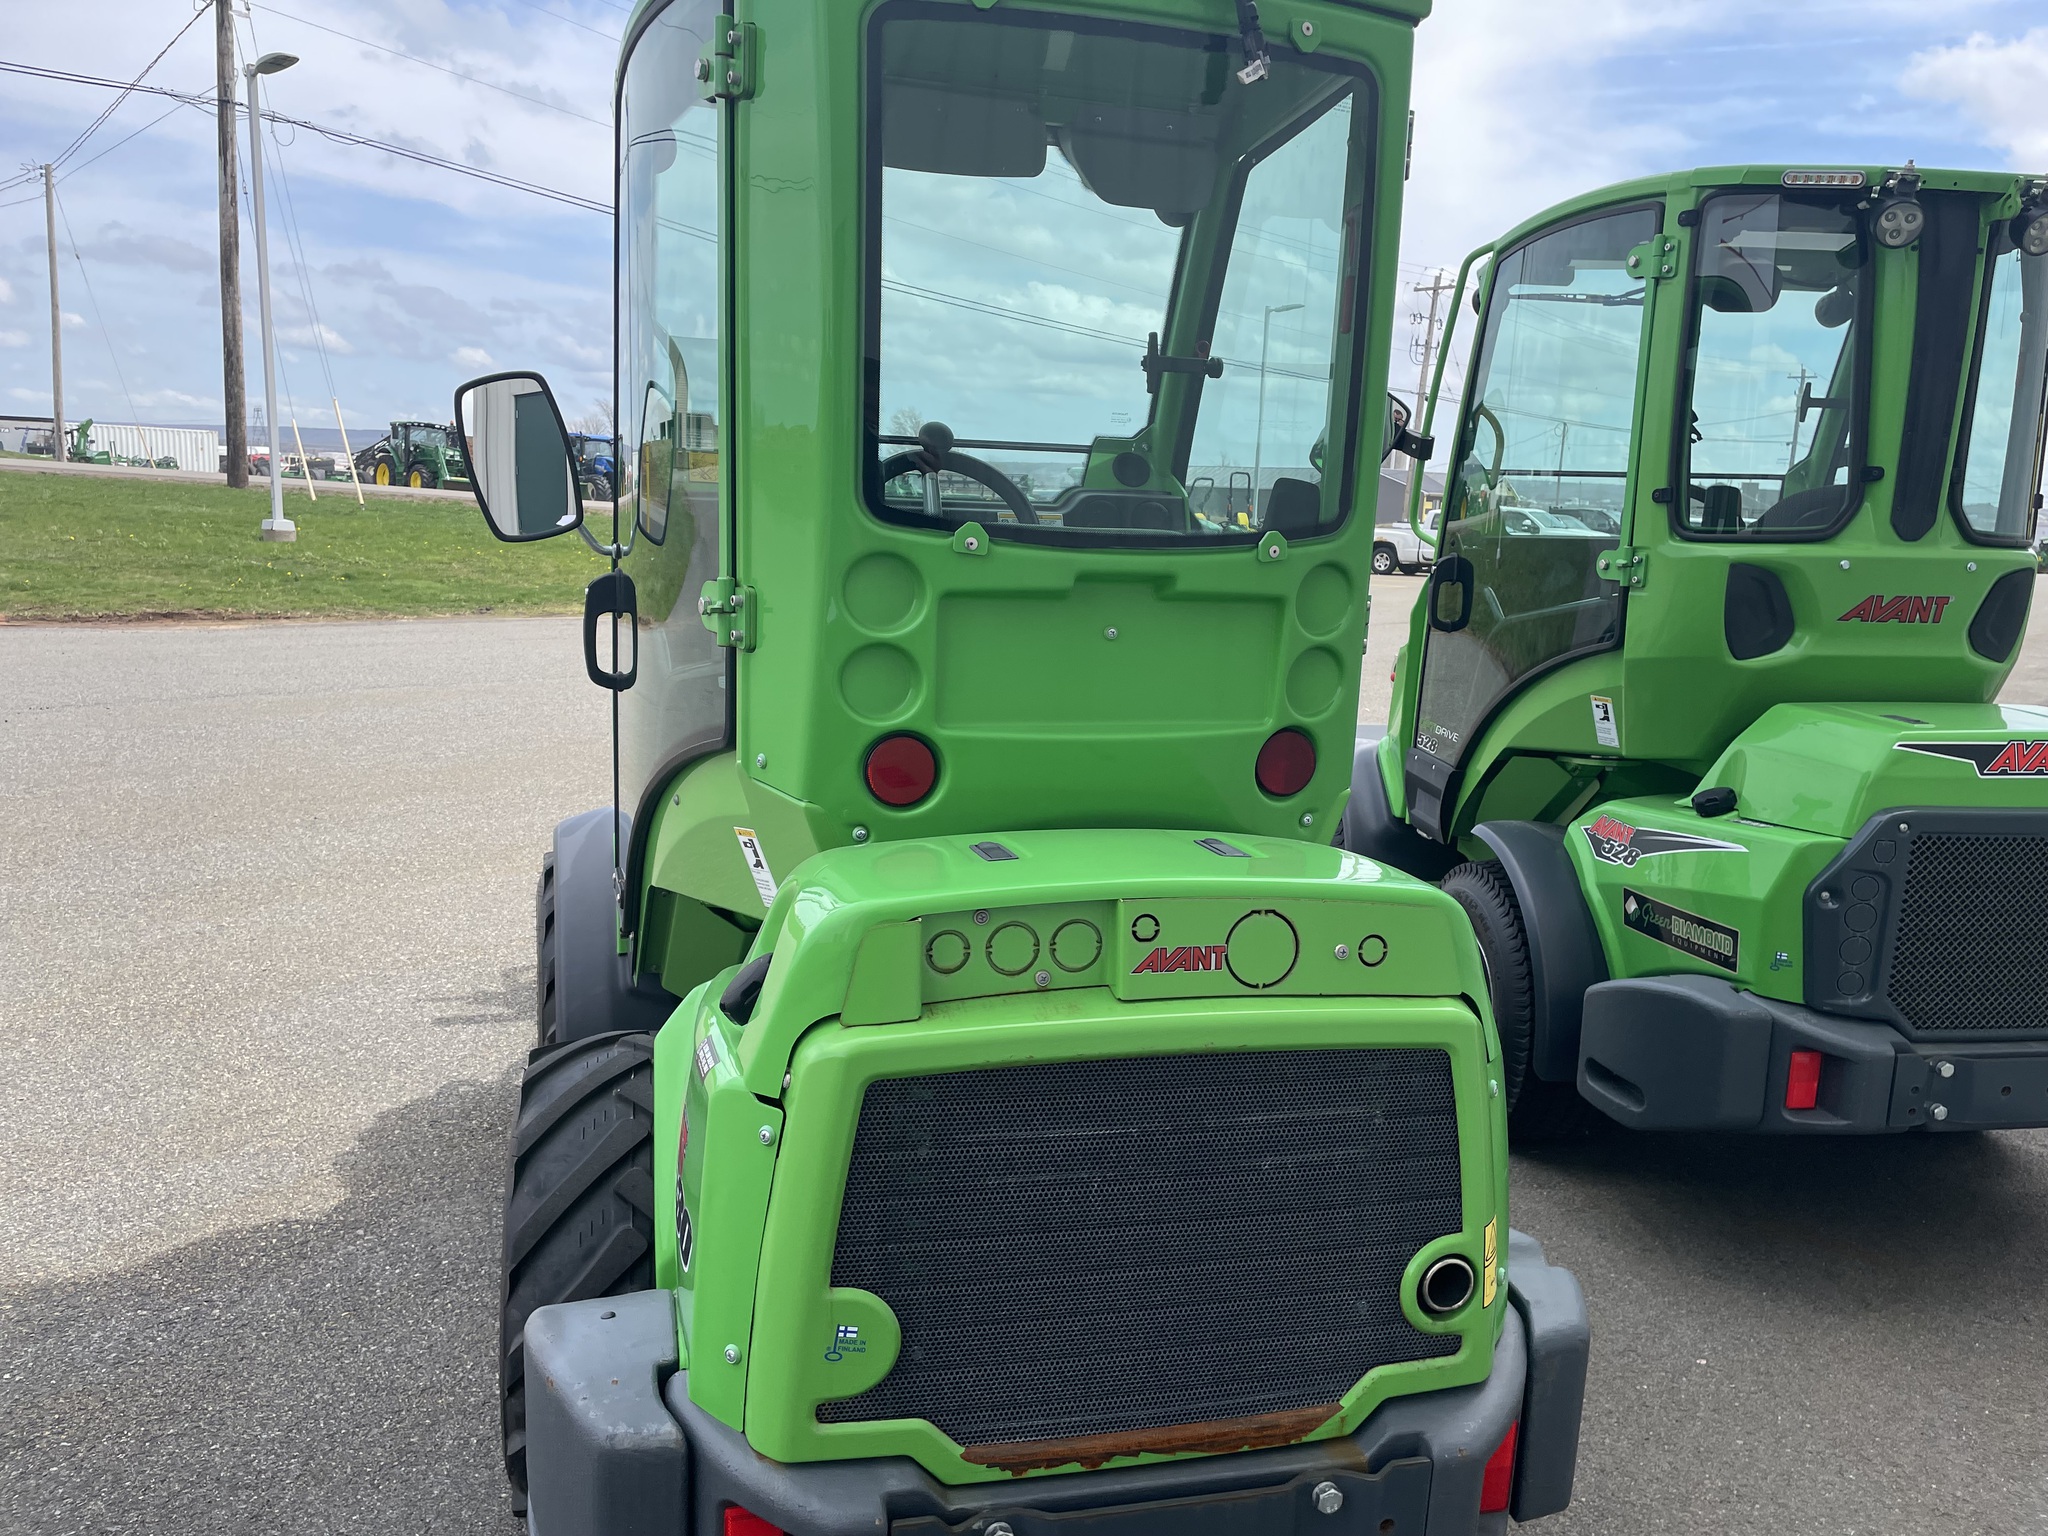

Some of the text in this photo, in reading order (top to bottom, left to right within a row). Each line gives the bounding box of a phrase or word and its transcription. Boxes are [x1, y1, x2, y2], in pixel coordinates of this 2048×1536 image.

[1836, 594, 1951, 624] AVANT
[1417, 732, 1438, 754] 528
[1588, 814, 1636, 845] AVANT
[1601, 837, 1641, 868] 528
[1672, 915, 1733, 956] DIAMOND
[1672, 936, 1725, 961] EQUIPMENT
[1130, 945, 1227, 974] AVANT
